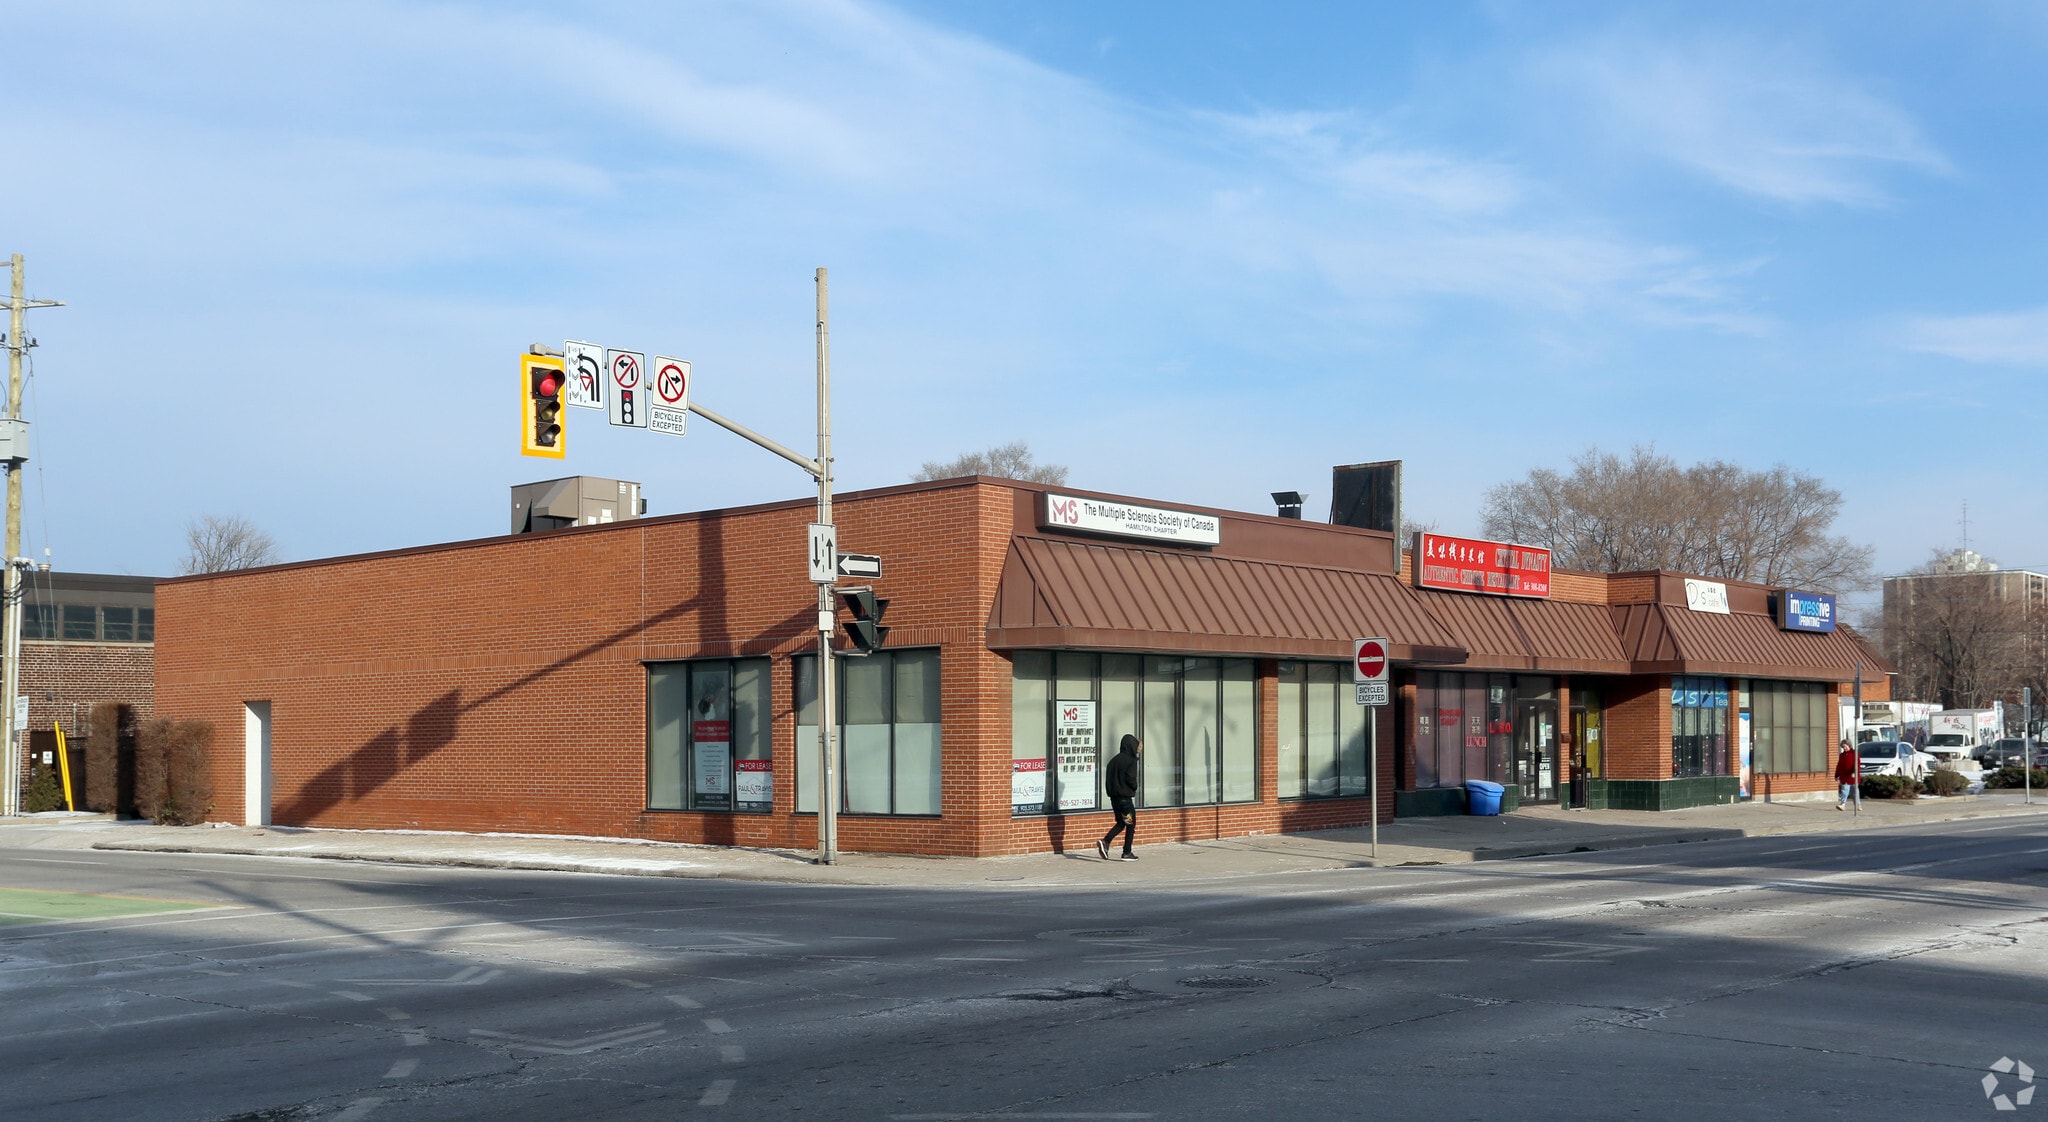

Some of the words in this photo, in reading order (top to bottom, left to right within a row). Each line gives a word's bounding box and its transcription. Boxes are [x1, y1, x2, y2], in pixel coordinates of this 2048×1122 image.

[654, 411, 683, 423] BICYCLES
[652, 420, 683, 432] EXCEPTED
[1052, 498, 1078, 525] MS
[1084, 503, 1097, 516] The
[1098, 504, 1126, 522] Multiple
[1127, 508, 1158, 524] Sclerosis
[1158, 513, 1183, 529] Society
[1183, 517, 1190, 528] of
[1191, 517, 1214, 532] Canada
[1125, 523, 1152, 532] HAMILTON
[1153, 526, 1178, 535] CHAPTER
[1460, 569, 1485, 586] CHINESE
[1487, 572, 1520, 590] RESTAURANT
[1790, 593, 1830, 623] impressive
[1800, 616, 1820, 627] PRINTING
[1359, 686, 1384, 694] BICYCLES
[1358, 694, 1385, 702] EXCEPTED
[1714, 697, 1728, 706] Tea
[1063, 707, 1078, 721] MS
[1466, 736, 1487, 747] LUNCH
[1072, 746, 1081, 754] NEW
[1081, 746, 1096, 754] OFFICE
[745, 762, 756, 770] FOR
[756, 762, 772, 770] LEASE
[1020, 761, 1032, 770] FOR
[1032, 761, 1046, 769] LEASE
